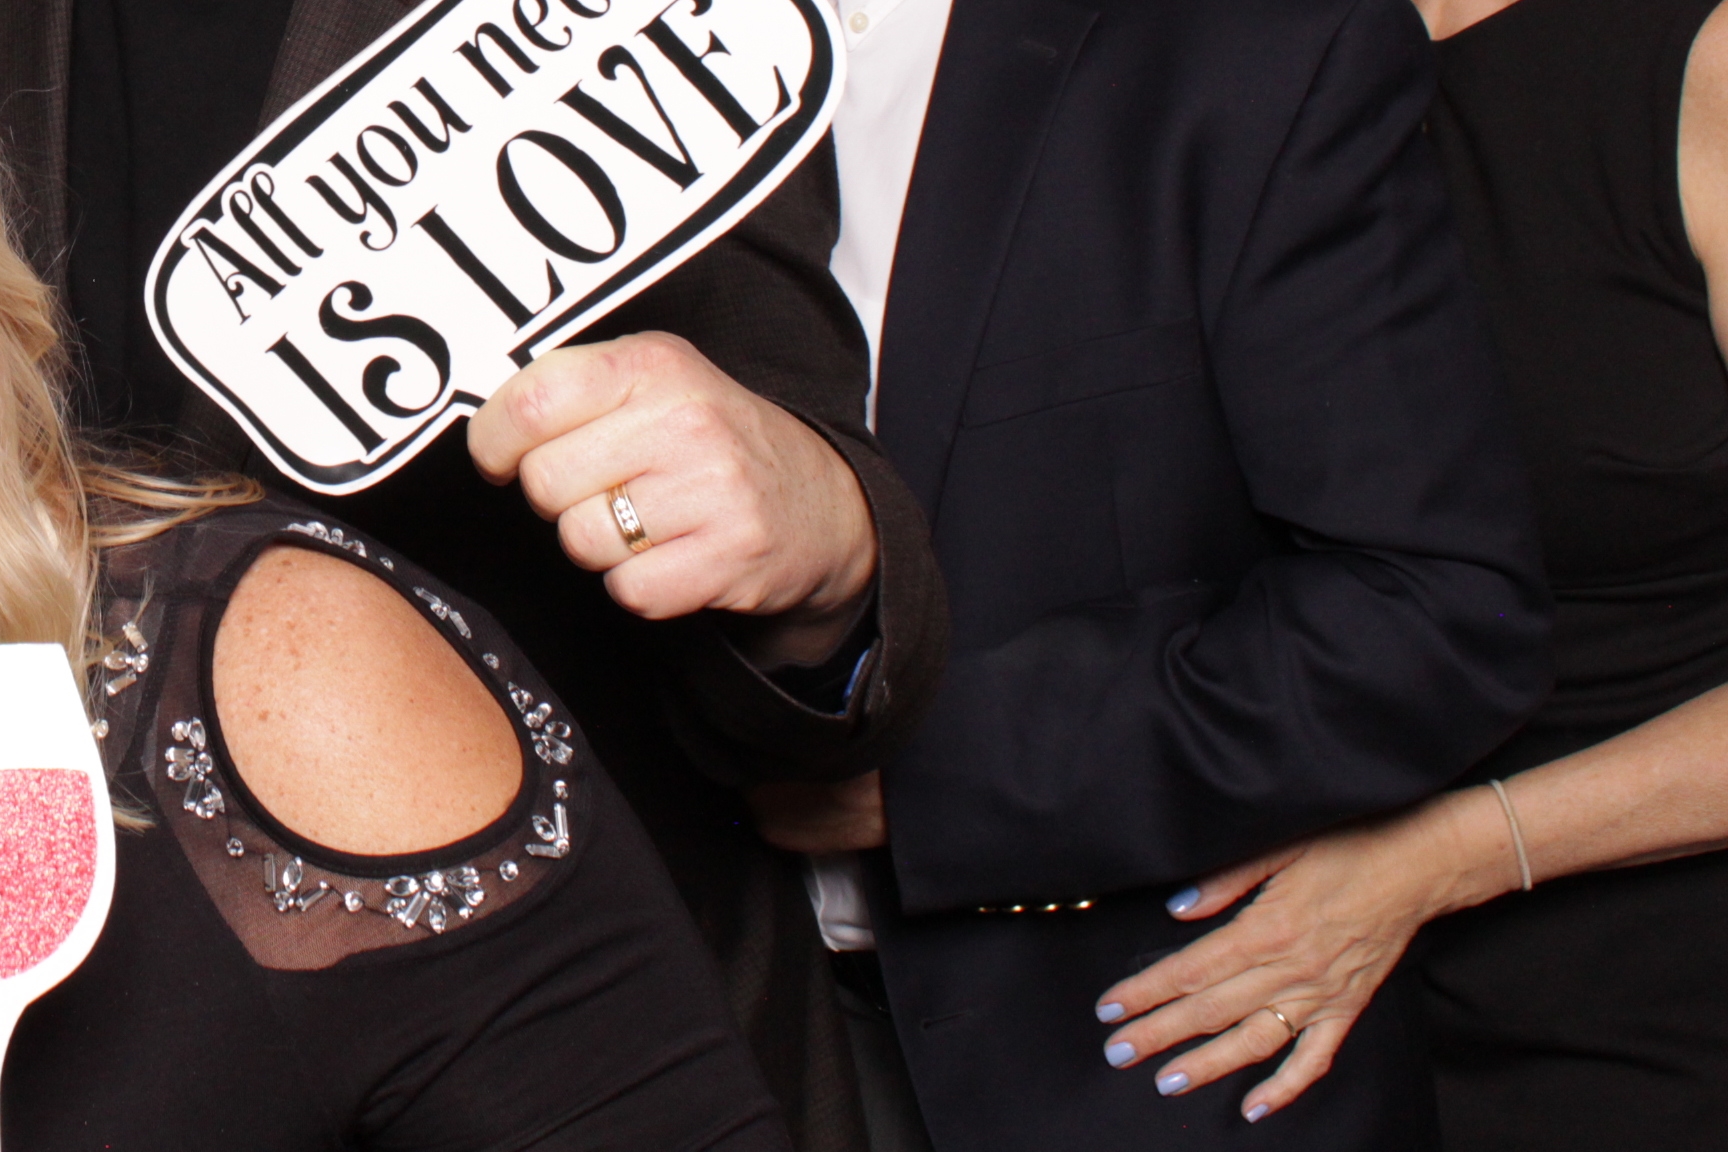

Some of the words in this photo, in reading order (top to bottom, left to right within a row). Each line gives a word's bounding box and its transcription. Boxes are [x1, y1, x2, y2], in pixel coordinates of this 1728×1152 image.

[188, 169, 325, 325] All
[304, 75, 474, 252] you
[264, 279, 452, 457] IS
